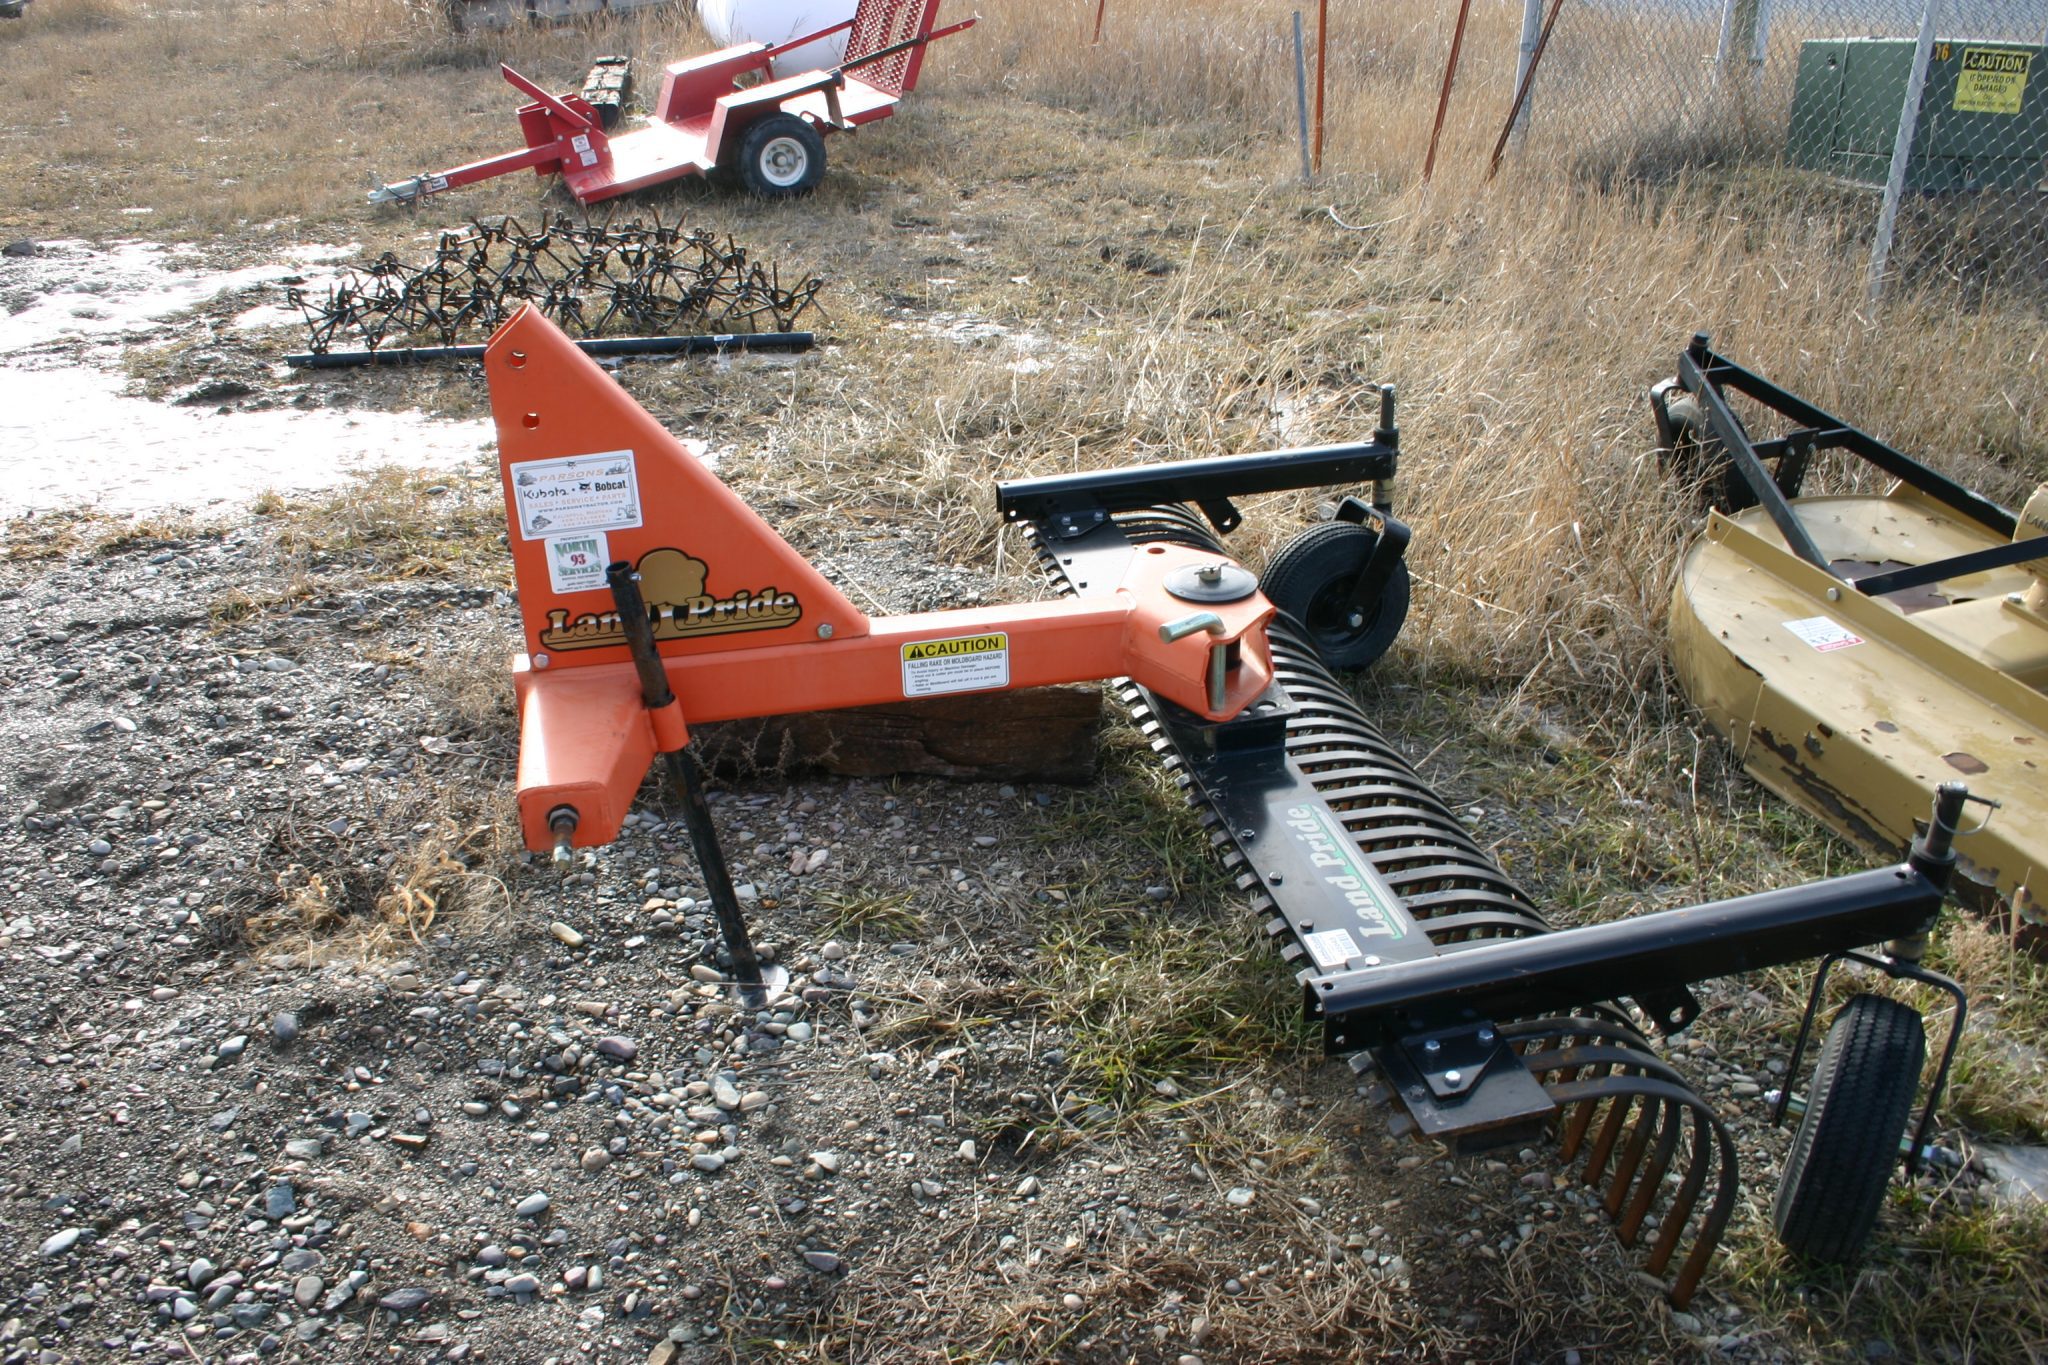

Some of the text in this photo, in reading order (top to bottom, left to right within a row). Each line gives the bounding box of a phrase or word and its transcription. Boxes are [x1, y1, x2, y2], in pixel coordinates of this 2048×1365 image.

[1970, 55, 2023, 71] CAUTION
[539, 468, 604, 482] PARSONS
[523, 480, 626, 500] Kubota Bobcat
[528, 492, 627, 509] SALES SERVICE PARTS
[553, 539, 599, 560] NORTH
[570, 553, 586, 566] 93
[558, 561, 602, 577] SERVICES
[684, 587, 796, 626] Pride
[925, 637, 999, 656] CAUTION
[907, 661, 928, 669] FALLING
[929, 659, 942, 667] RAKE
[951, 655, 982, 665] MOLDBOARD
[983, 652, 1002, 661] HAZARD
[1286, 807, 1346, 868] Pride
[1325, 875, 1397, 937] Land
